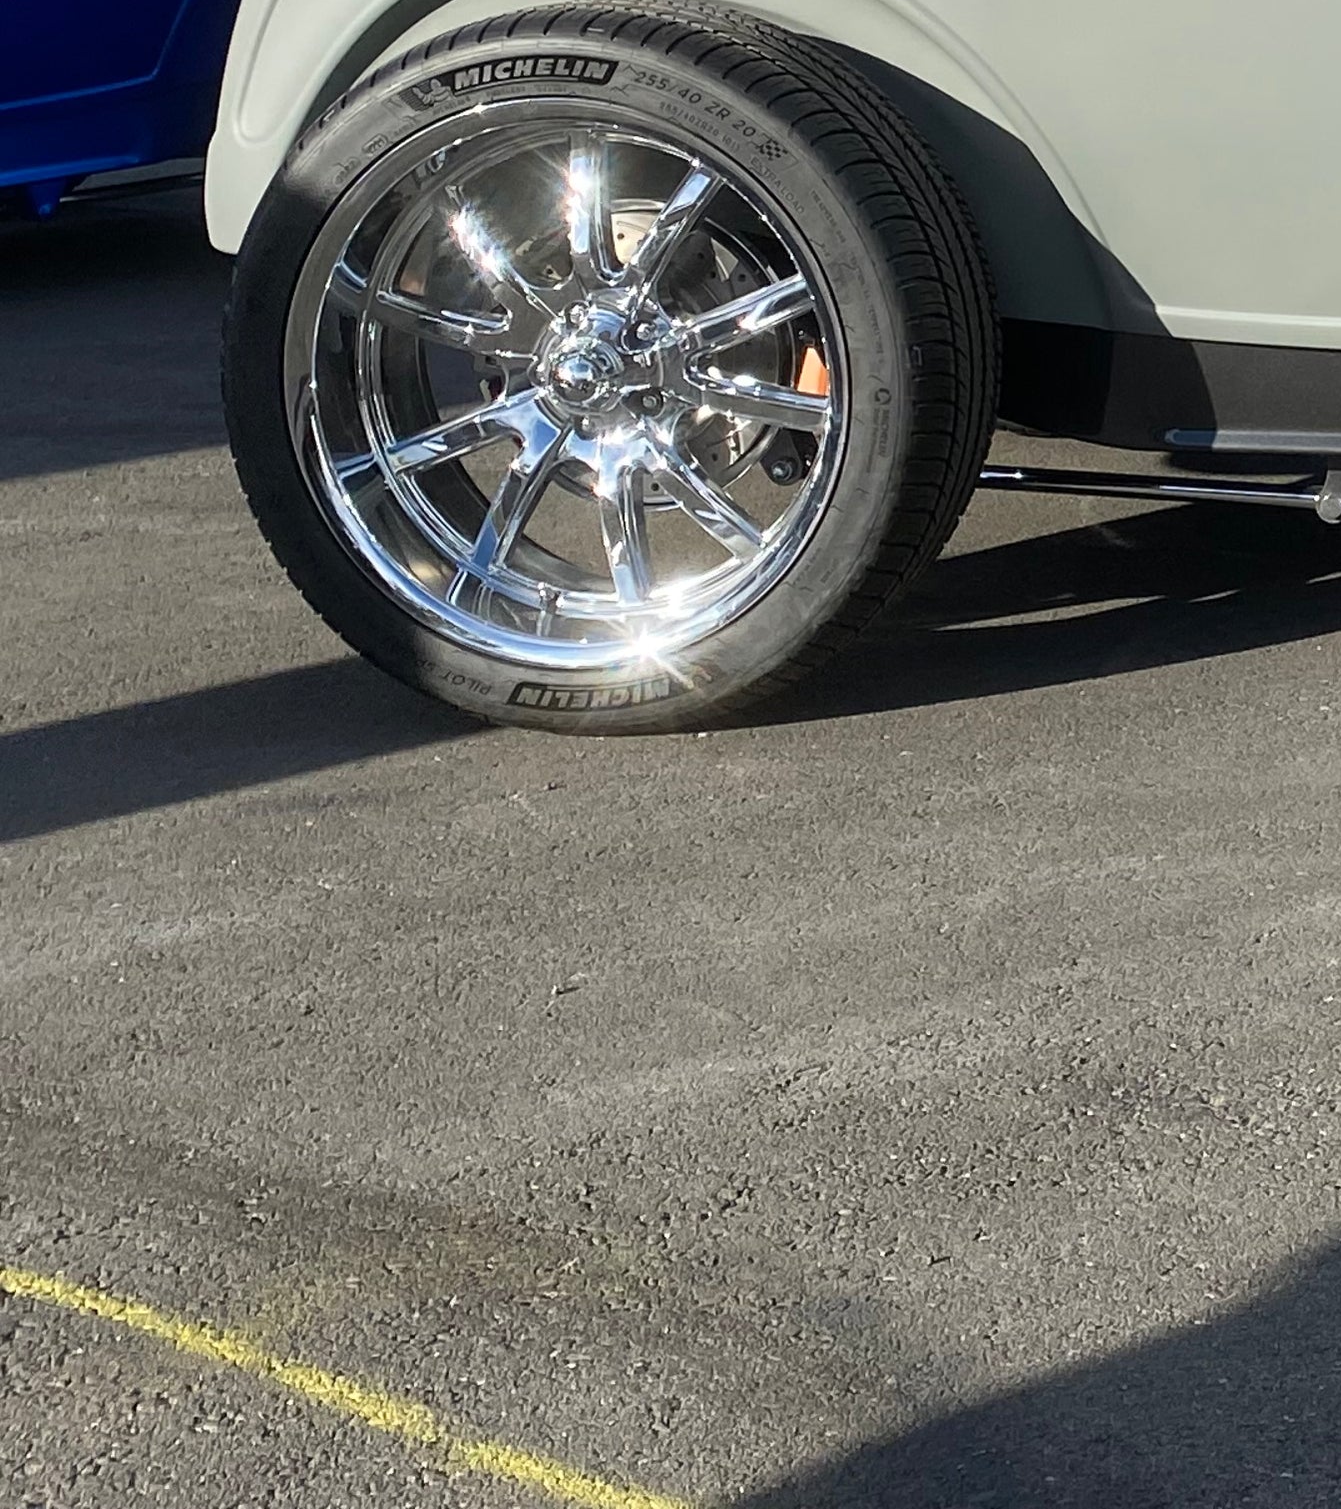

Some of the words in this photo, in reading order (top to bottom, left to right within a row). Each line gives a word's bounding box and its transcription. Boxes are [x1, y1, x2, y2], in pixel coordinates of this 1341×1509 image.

[454, 58, 609, 90] MICHELIN
[634, 71, 702, 104] 255/40
[704, 100, 731, 121] ZR
[732, 119, 757, 138] 20
[780, 187, 805, 215] LOAD
[441, 670, 491, 695] PILOT
[516, 678, 671, 709] MICHELIN
